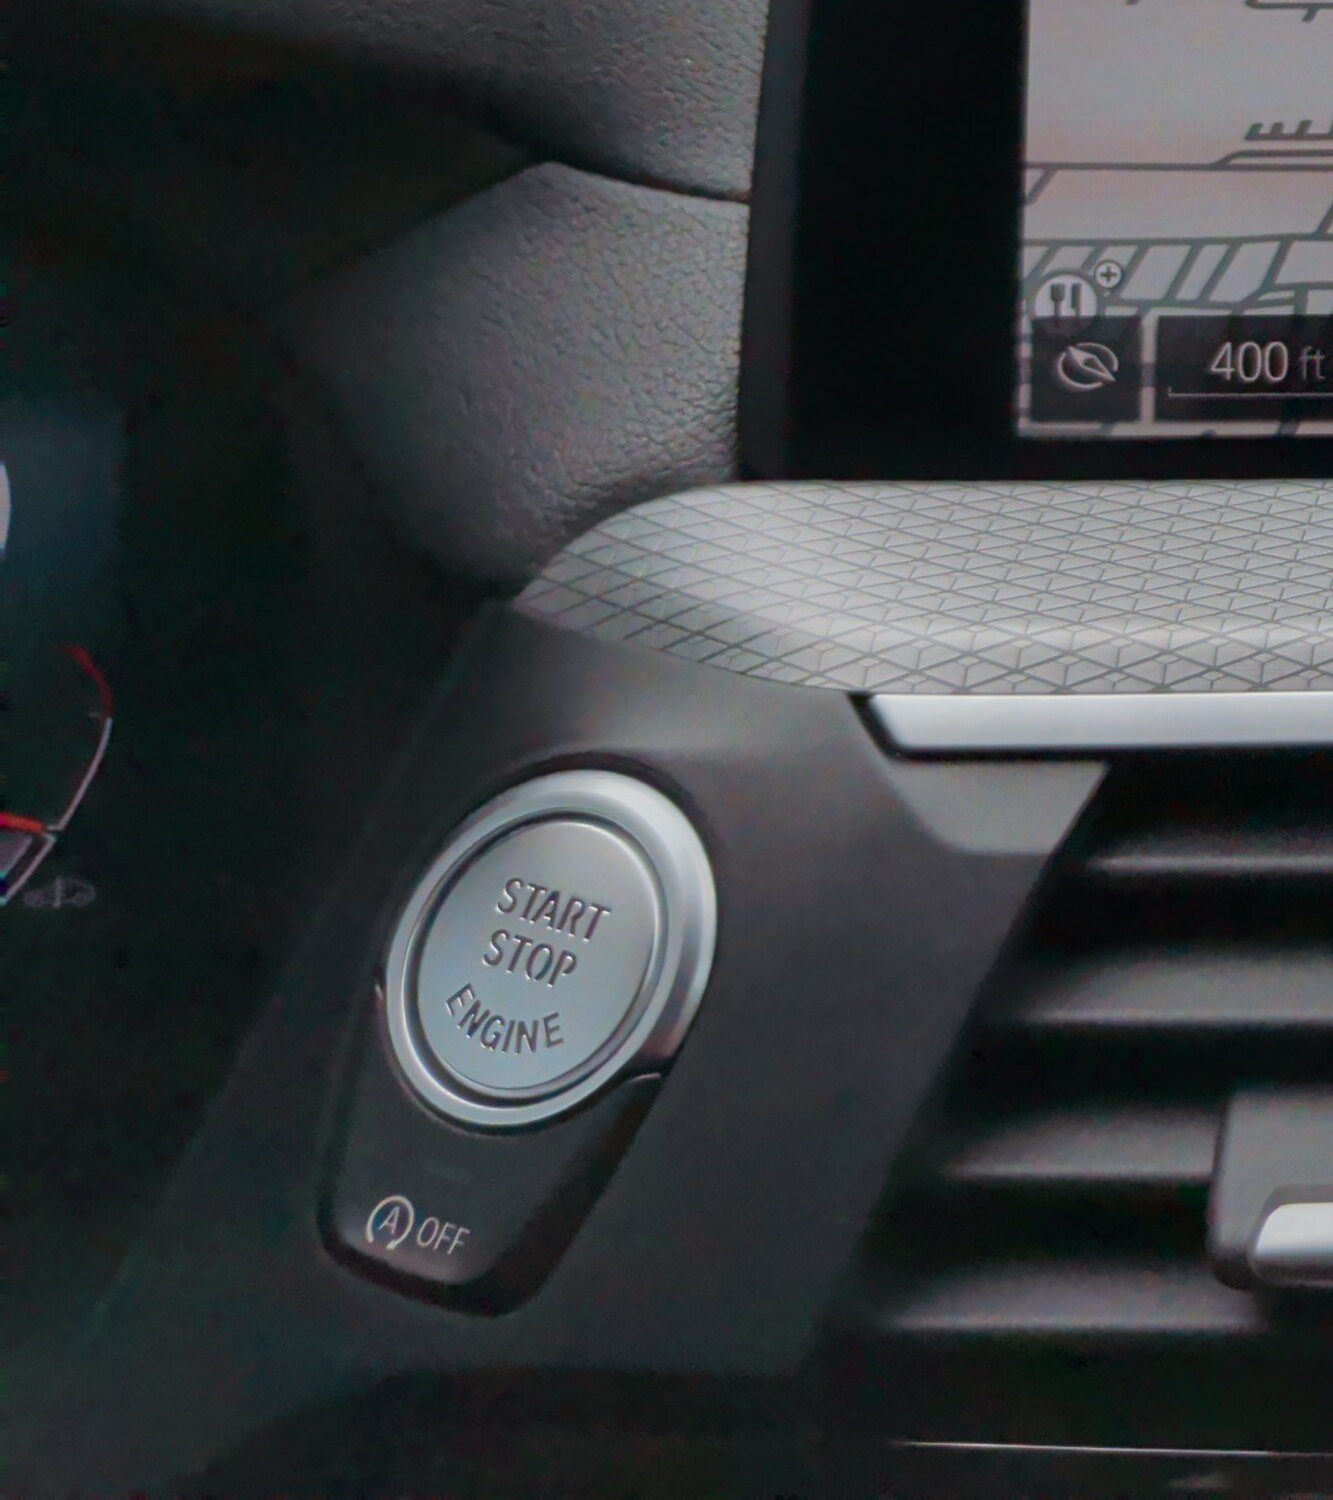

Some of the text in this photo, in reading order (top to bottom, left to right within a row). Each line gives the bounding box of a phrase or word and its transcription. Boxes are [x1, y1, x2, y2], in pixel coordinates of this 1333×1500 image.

[1209, 341, 1326, 382] 400 ft
[496, 876, 612, 942] START
[482, 928, 577, 988] STOP
[445, 983, 565, 1056] ENGINE
[416, 1216, 472, 1256] OFF
